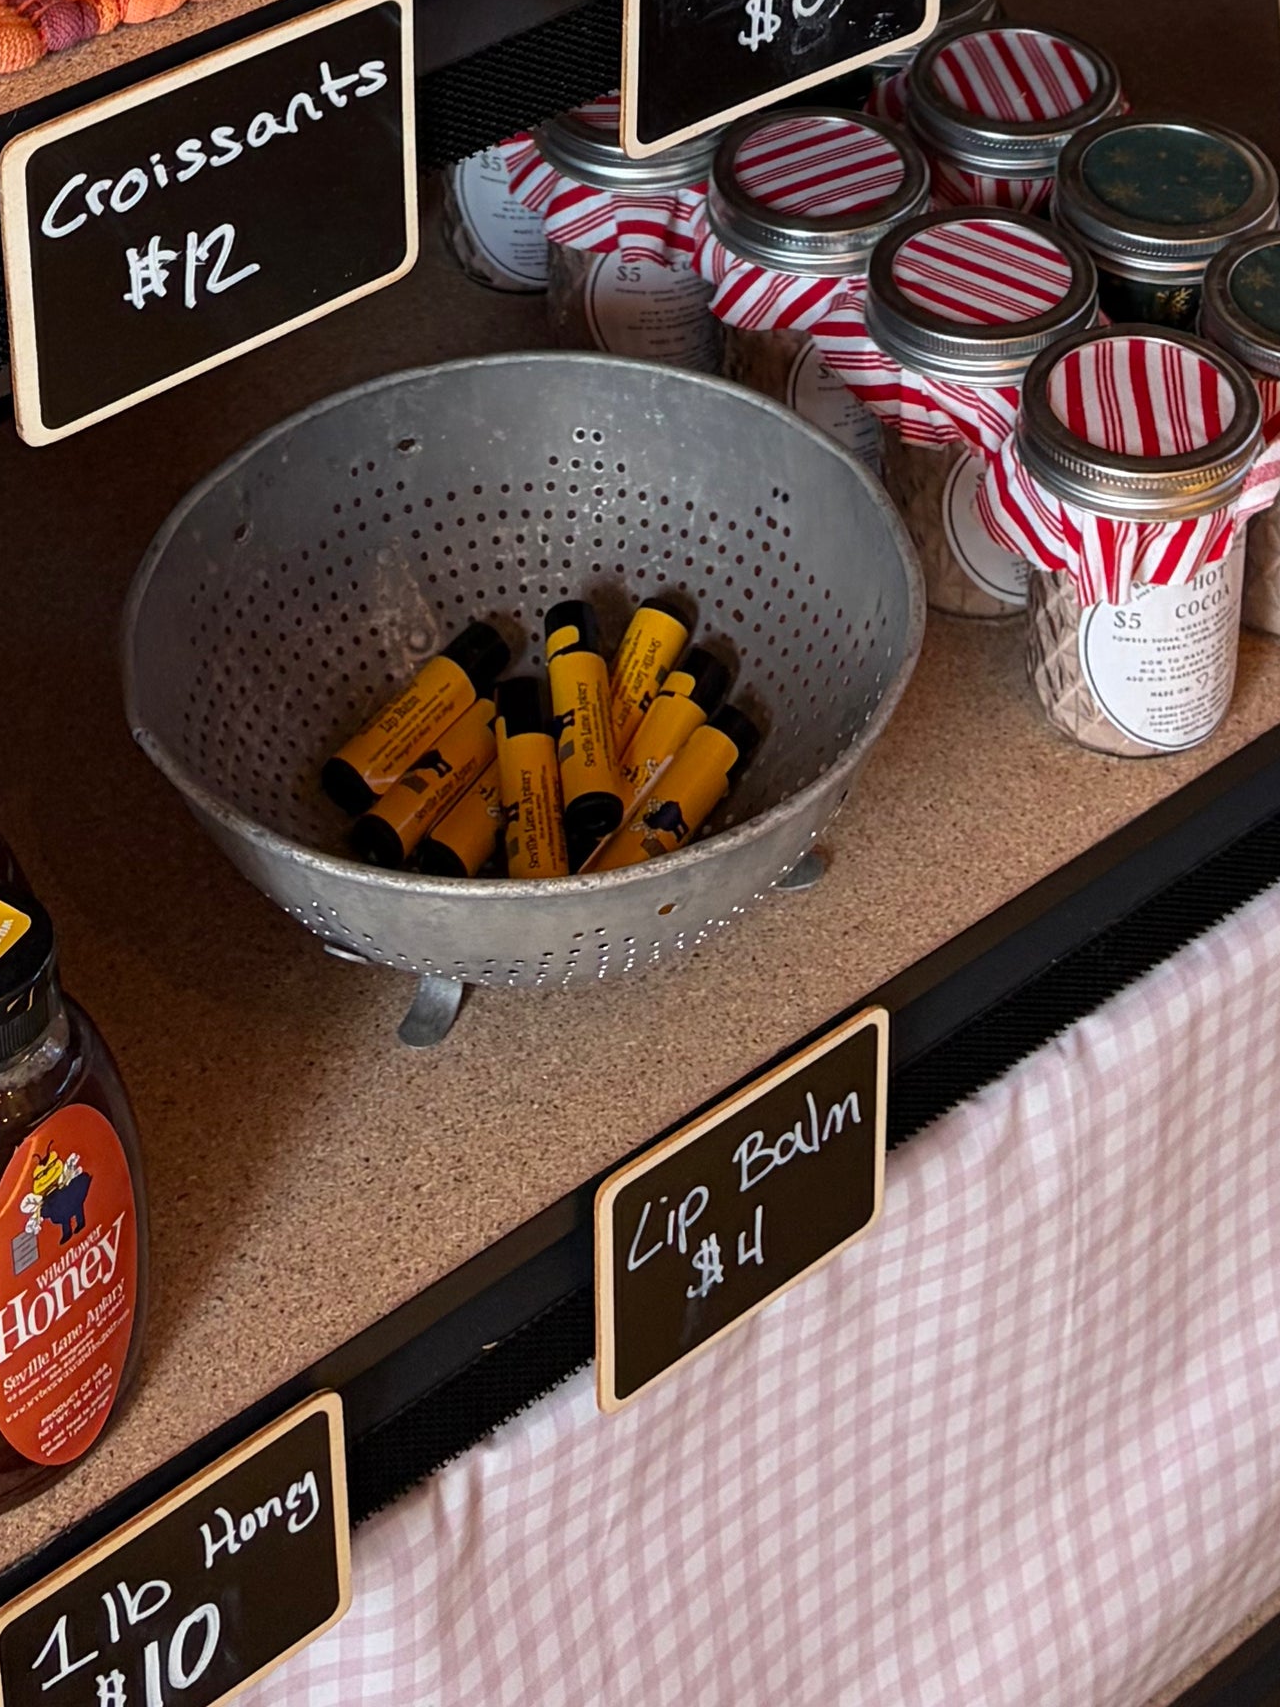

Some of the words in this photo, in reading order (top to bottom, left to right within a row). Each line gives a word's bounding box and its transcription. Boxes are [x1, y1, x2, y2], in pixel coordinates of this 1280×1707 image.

[40, 59, 389, 239] Croissants
[122, 222, 262, 311] $12
[1113, 610, 1143, 630] $5
[1191, 562, 1228, 592] HOT
[626, 1184, 710, 1272] Lip
[731, 1090, 862, 1193] Balm
[35, 1224, 102, 1291] Wildflower
[686, 1203, 765, 1299] $4
[30, 1613, 100, 1692] 1
[100, 1579, 172, 1645] lb
[198, 1469, 322, 1570] Honey
